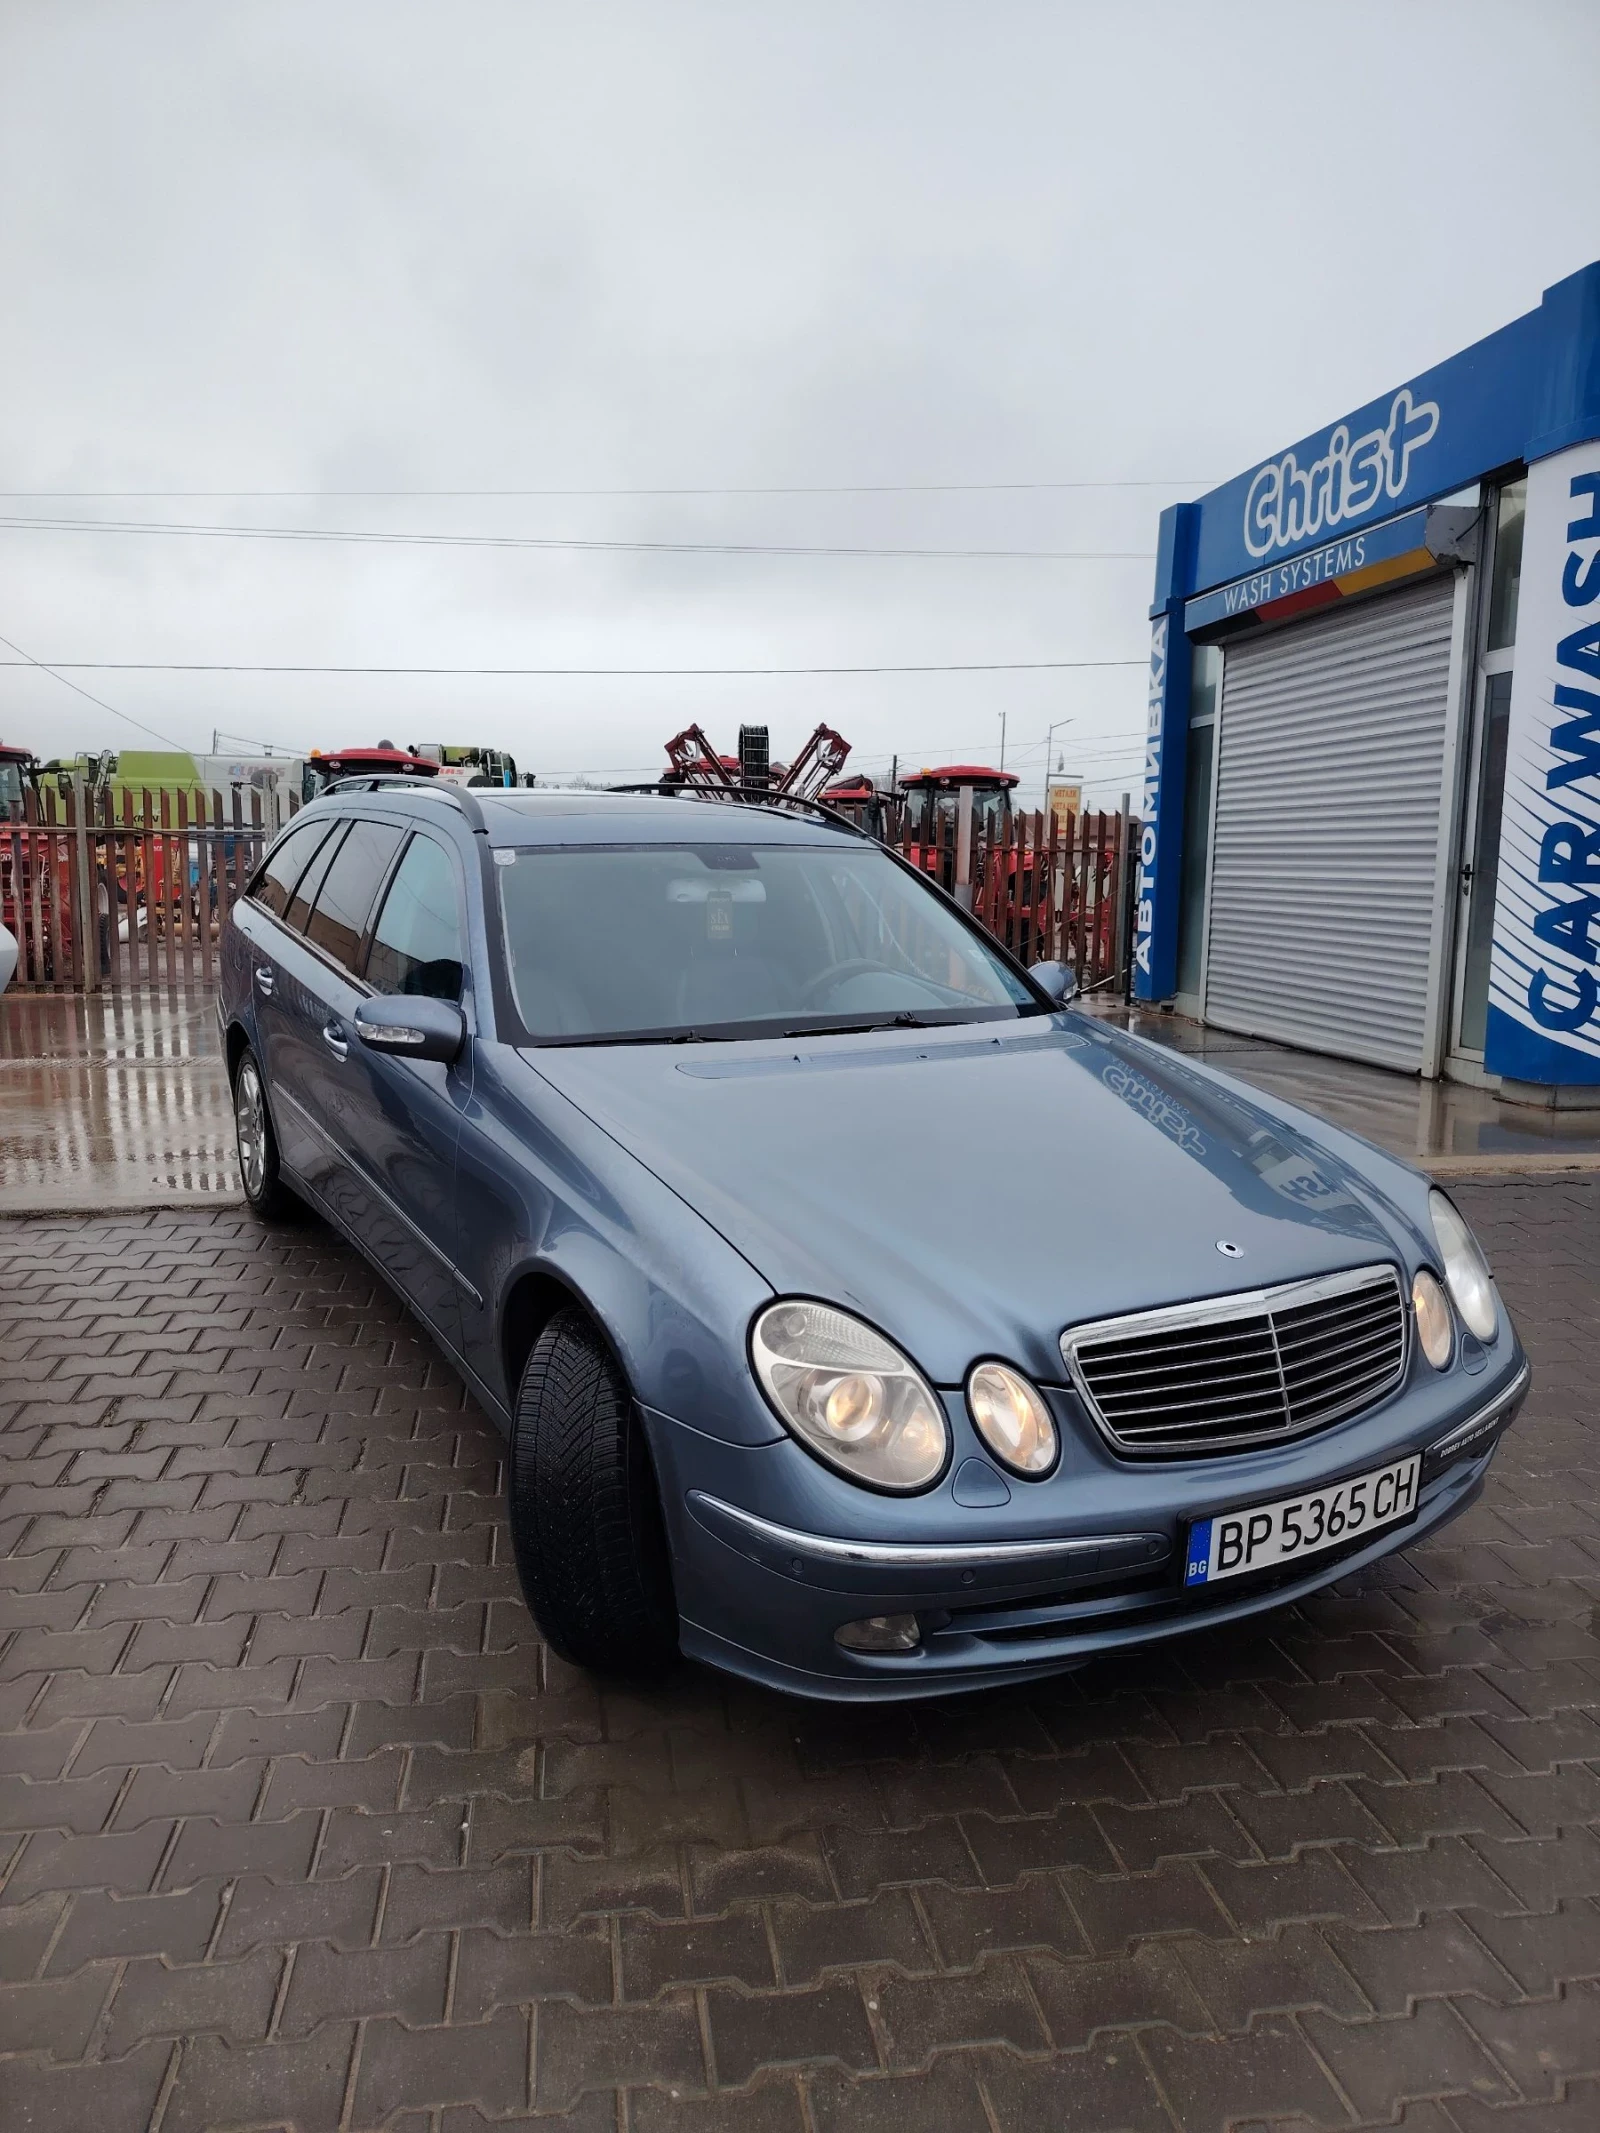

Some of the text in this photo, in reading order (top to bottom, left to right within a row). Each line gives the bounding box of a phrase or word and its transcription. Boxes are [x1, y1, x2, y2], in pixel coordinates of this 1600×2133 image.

[1244, 389, 1439, 557] Christ
[1224, 537, 1365, 614] WASH SYSTEMS
[1136, 617, 1168, 976] АВТОМИВКА
[1528, 822, 1600, 1032] CAR
[1188, 1559, 1207, 1577] BG
[1216, 1462, 1415, 1571] BP 5365 CH
